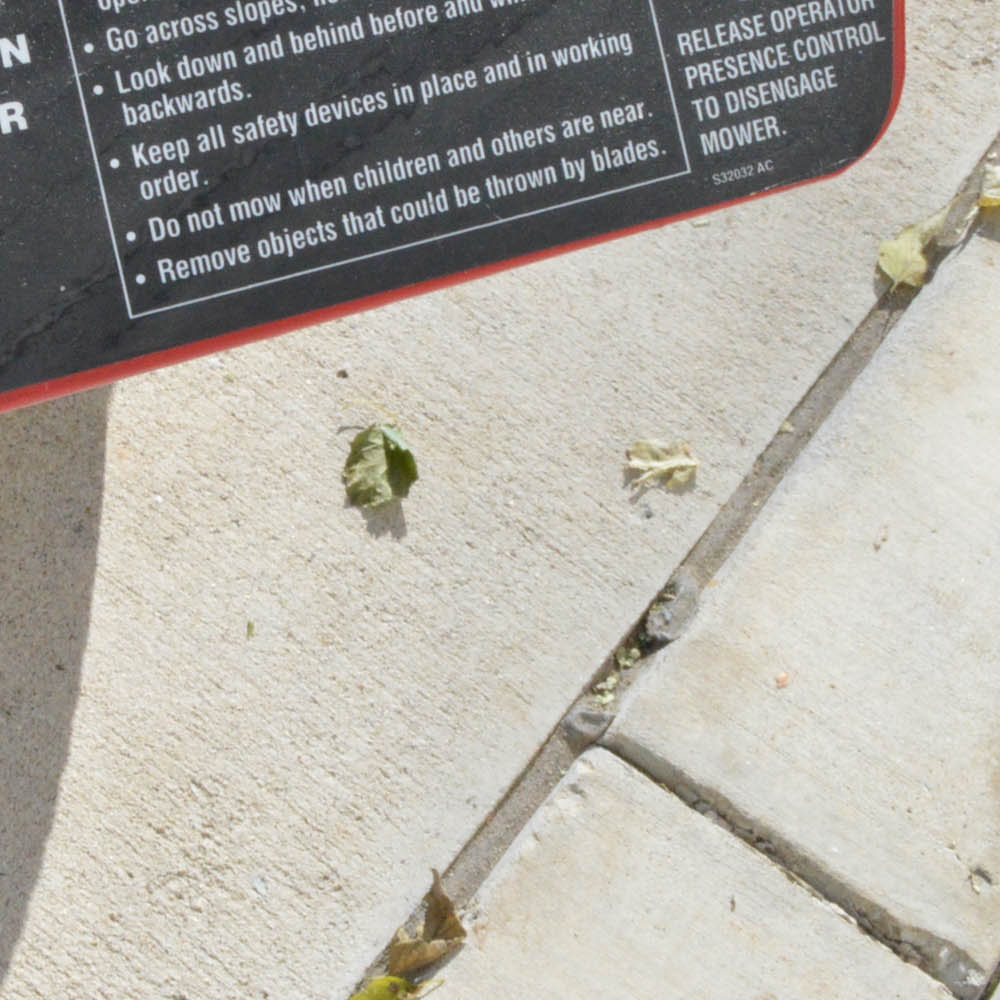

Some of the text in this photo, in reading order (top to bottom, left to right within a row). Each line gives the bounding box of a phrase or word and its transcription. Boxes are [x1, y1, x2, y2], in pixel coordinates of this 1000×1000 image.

[105, 26, 139, 53] Go
[144, 10, 220, 45] across
[114, 59, 172, 95] Look
[176, 49, 238, 81] down
[242, 33, 285, 66] and
[288, 15, 365, 55] behind
[368, 4, 439, 37] before
[676, 13, 767, 56] RELEASE
[684, 20, 886, 90] PRESENCE CONTROL
[121, 78, 252, 127] backwards.
[130, 32, 634, 169] Keep all safety devices in place and in working
[690, 65, 838, 122] TO DISENGAGE
[699, 115, 787, 156] MOWER.
[139, 168, 209, 201] order.
[147, 101, 653, 243] Do not mow when children and others are near.
[711, 159, 774, 185] S32032 AC
[156, 139, 667, 284] Remove objects that could be thrown by blades.
